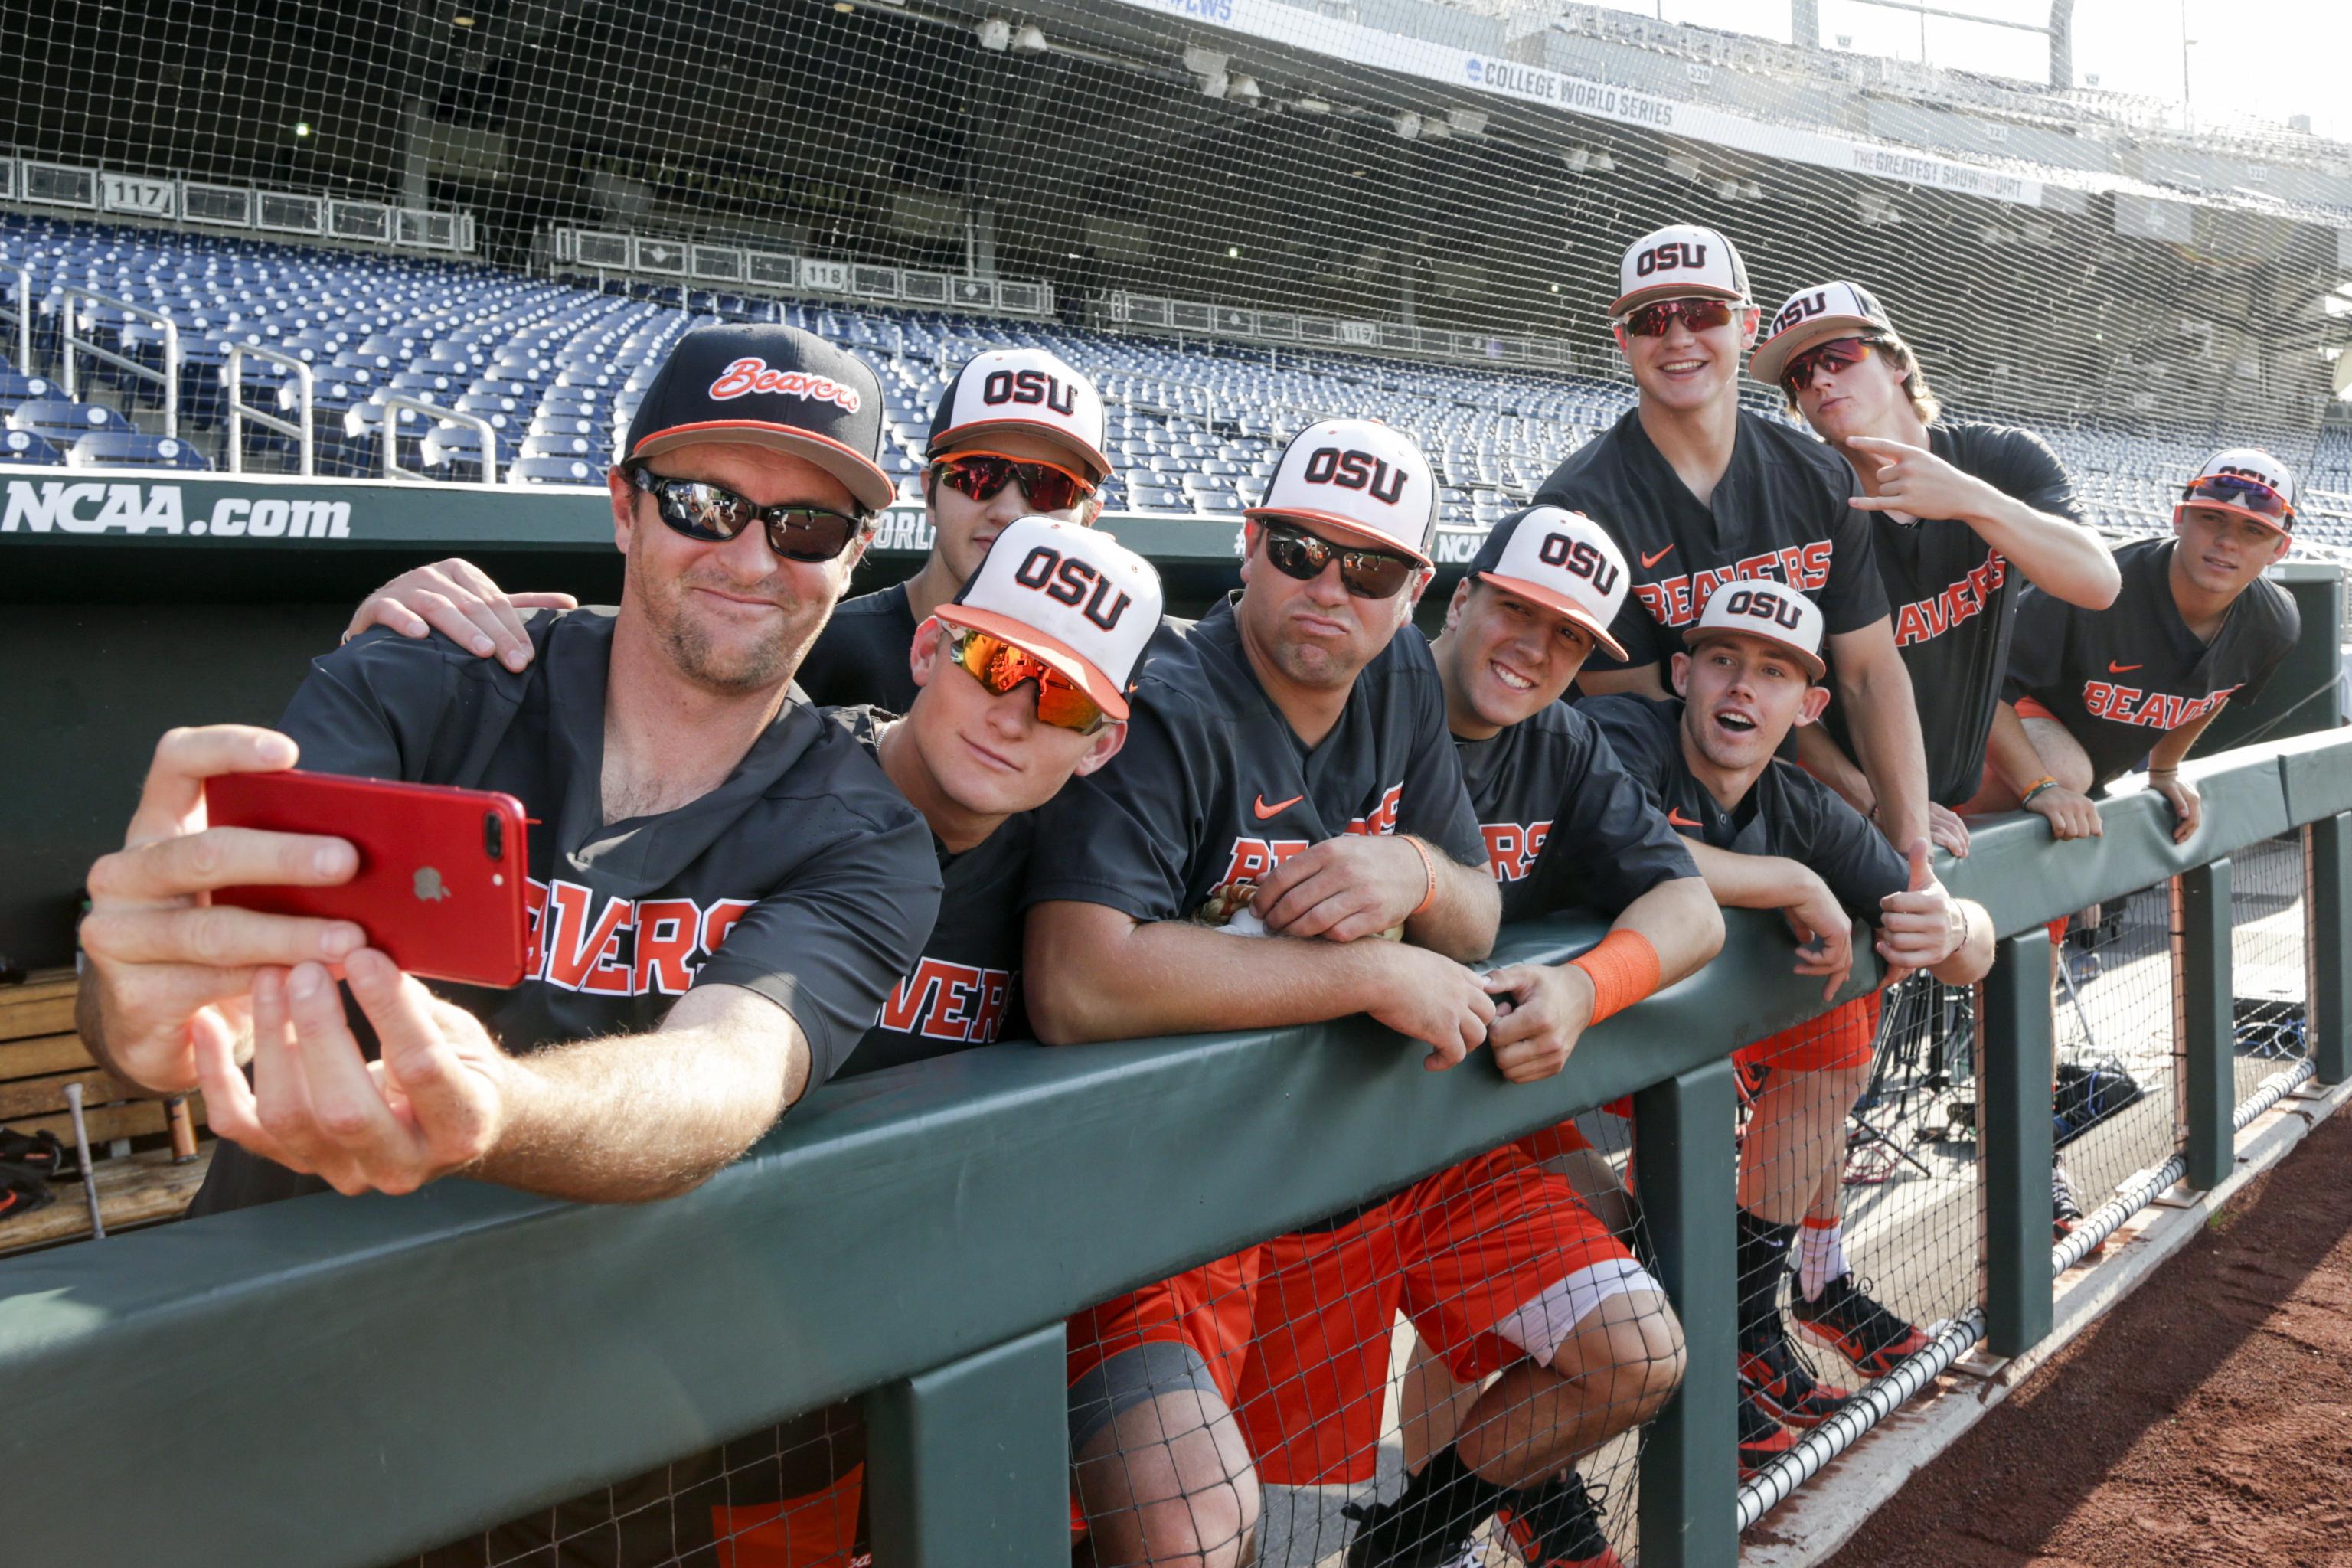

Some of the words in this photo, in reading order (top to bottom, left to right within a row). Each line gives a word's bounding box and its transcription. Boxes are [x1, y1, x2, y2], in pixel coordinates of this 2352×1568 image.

[1485, 63, 1555, 99] COLLEGE
[1560, 80, 1615, 113] WORLD
[1619, 94, 1673, 126] SERIES
[1876, 152, 1939, 181] GREATEST
[114, 181, 161, 205] 117
[810, 266, 841, 284] 118
[1636, 242, 1707, 277] OSU
[1772, 292, 1827, 335] OSU
[709, 357, 861, 413] Beavers
[983, 369, 1079, 416] OSU
[1304, 447, 1409, 506] OSU
[1, 480, 351, 537] NCAA.com
[1437, 534, 1488, 563] NCA
[1539, 532, 1619, 597] OSU
[1014, 545, 1133, 632] OSU
[1726, 590, 1803, 630] OSU
